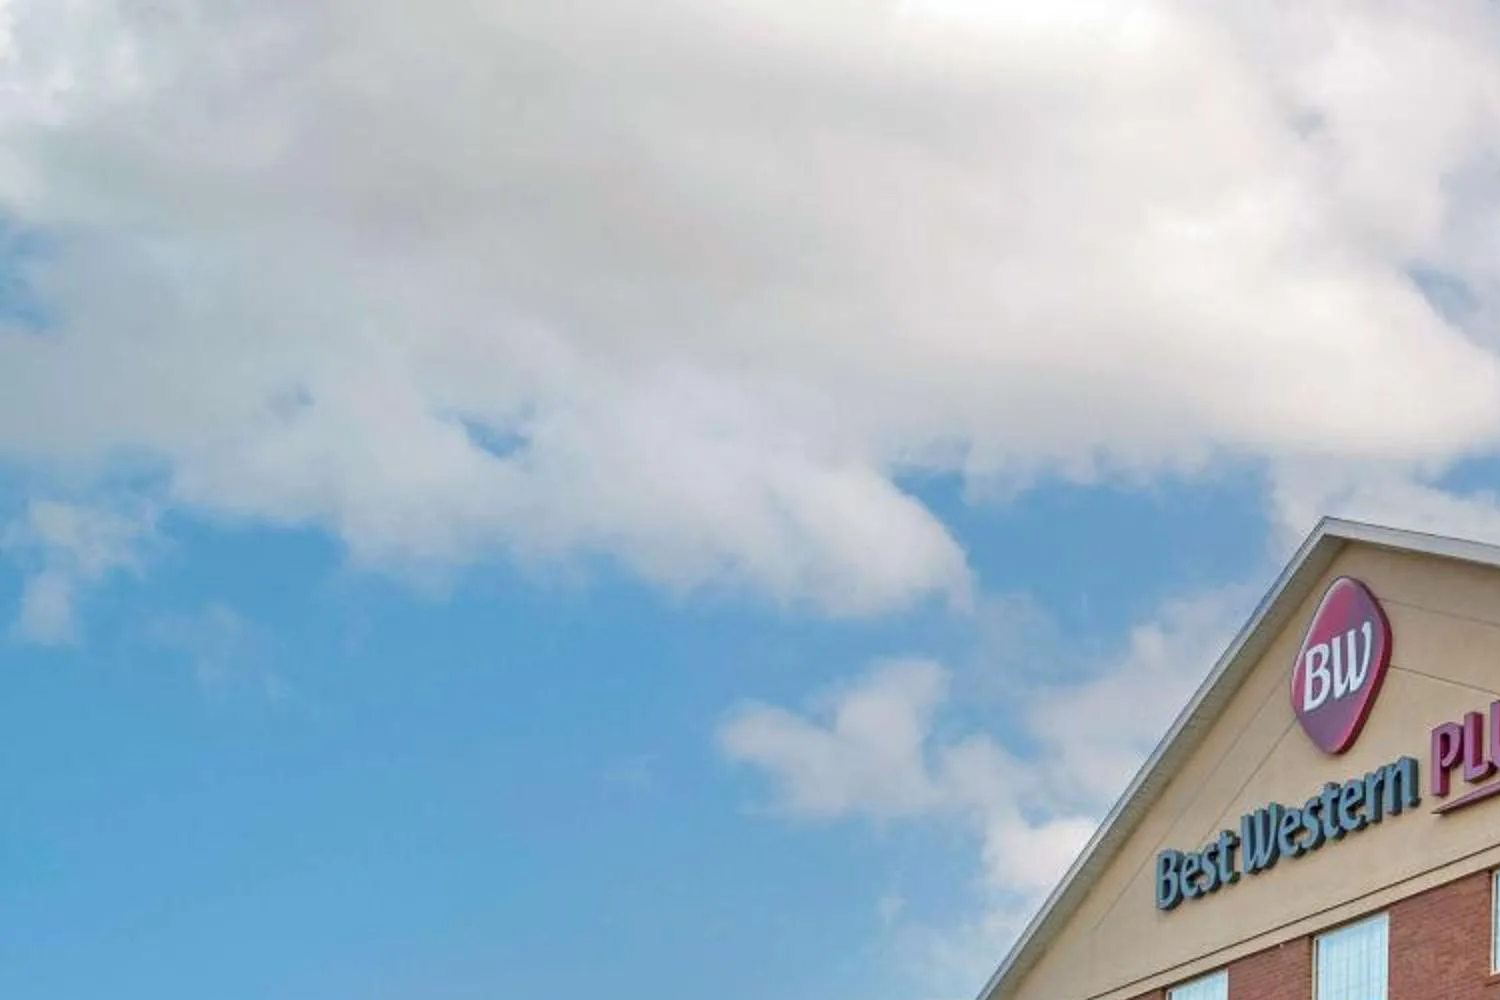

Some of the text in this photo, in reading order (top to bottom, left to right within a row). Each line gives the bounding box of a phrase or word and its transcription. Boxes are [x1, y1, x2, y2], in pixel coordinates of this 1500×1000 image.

[1302, 621, 1371, 712] BW
[1156, 829, 1240, 911] Best
[1239, 756, 1421, 873] Western
